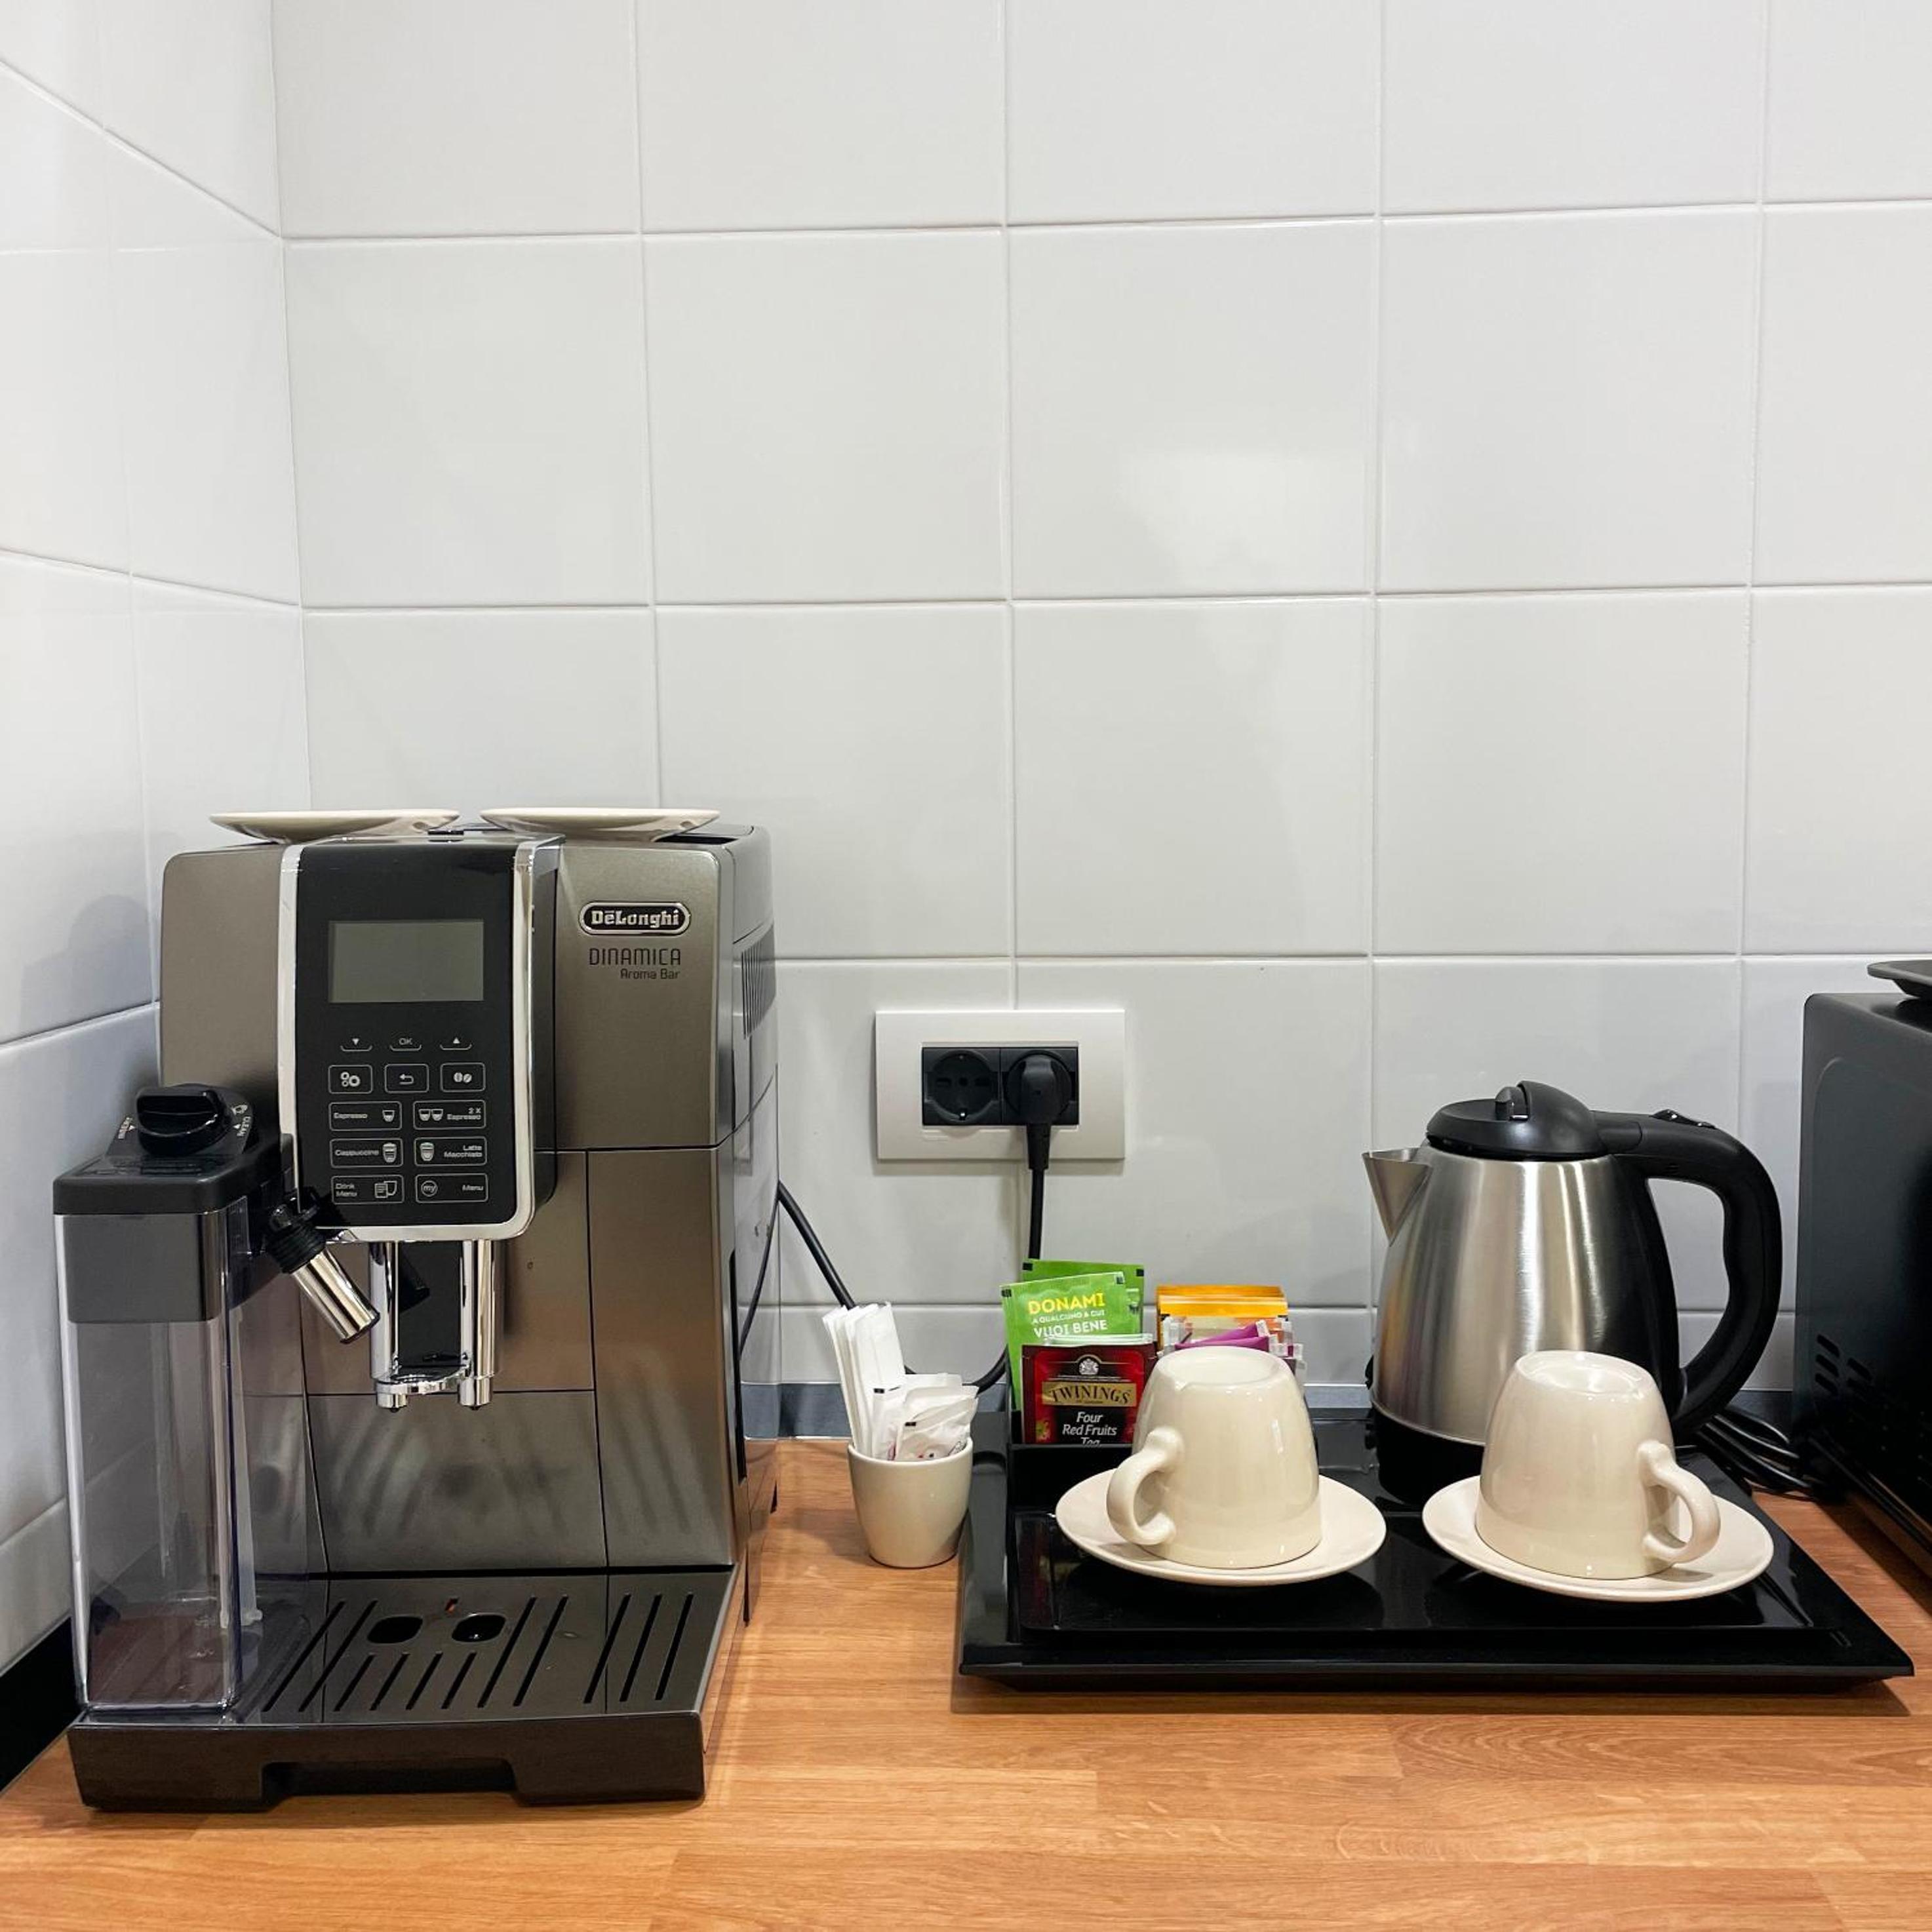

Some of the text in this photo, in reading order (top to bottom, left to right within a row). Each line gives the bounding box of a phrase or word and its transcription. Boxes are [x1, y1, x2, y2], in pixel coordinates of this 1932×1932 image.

[589, 948, 680, 966] DINAMICA
[620, 968, 680, 979] Aroma Bar
[1029, 1293, 1105, 1314] DONAMI
[1034, 1320, 1108, 1338] VUOI BENE
[1050, 1385, 1132, 1404] TWININGS
[1076, 1411, 1103, 1423] Four
[1062, 1424, 1117, 1435] Red Fruits
